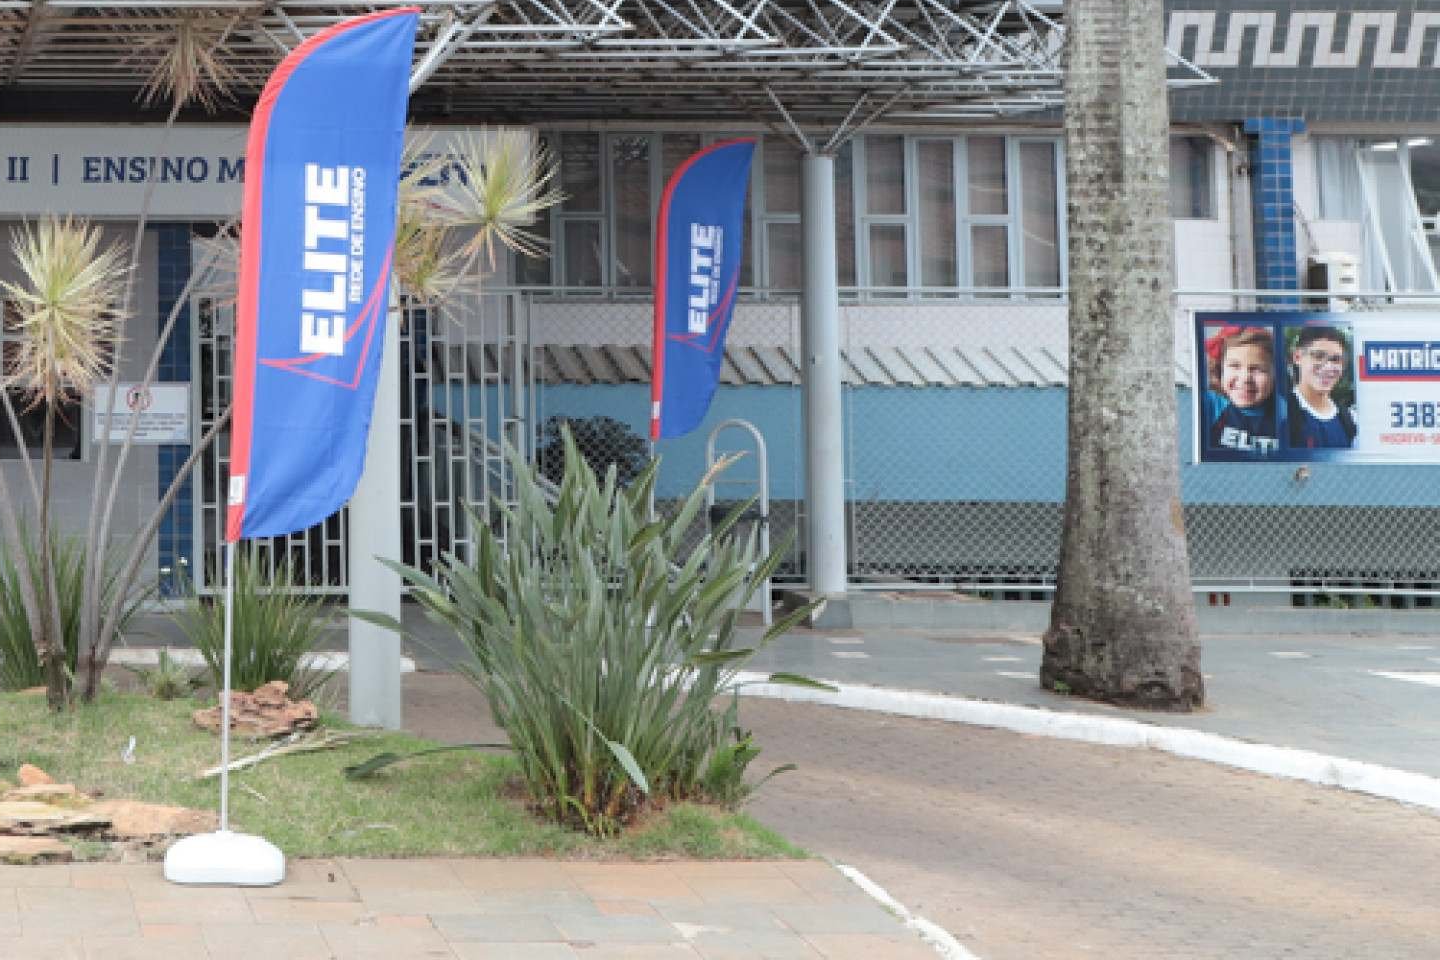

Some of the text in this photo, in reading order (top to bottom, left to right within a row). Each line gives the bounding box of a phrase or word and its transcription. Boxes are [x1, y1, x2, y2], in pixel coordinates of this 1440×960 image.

[7, 155, 31, 182] II
[81, 156, 208, 183] ENSINO
[300, 162, 350, 356] ELITE
[687, 223, 715, 334] ELITE
[1390, 401, 1440, 428] 338
